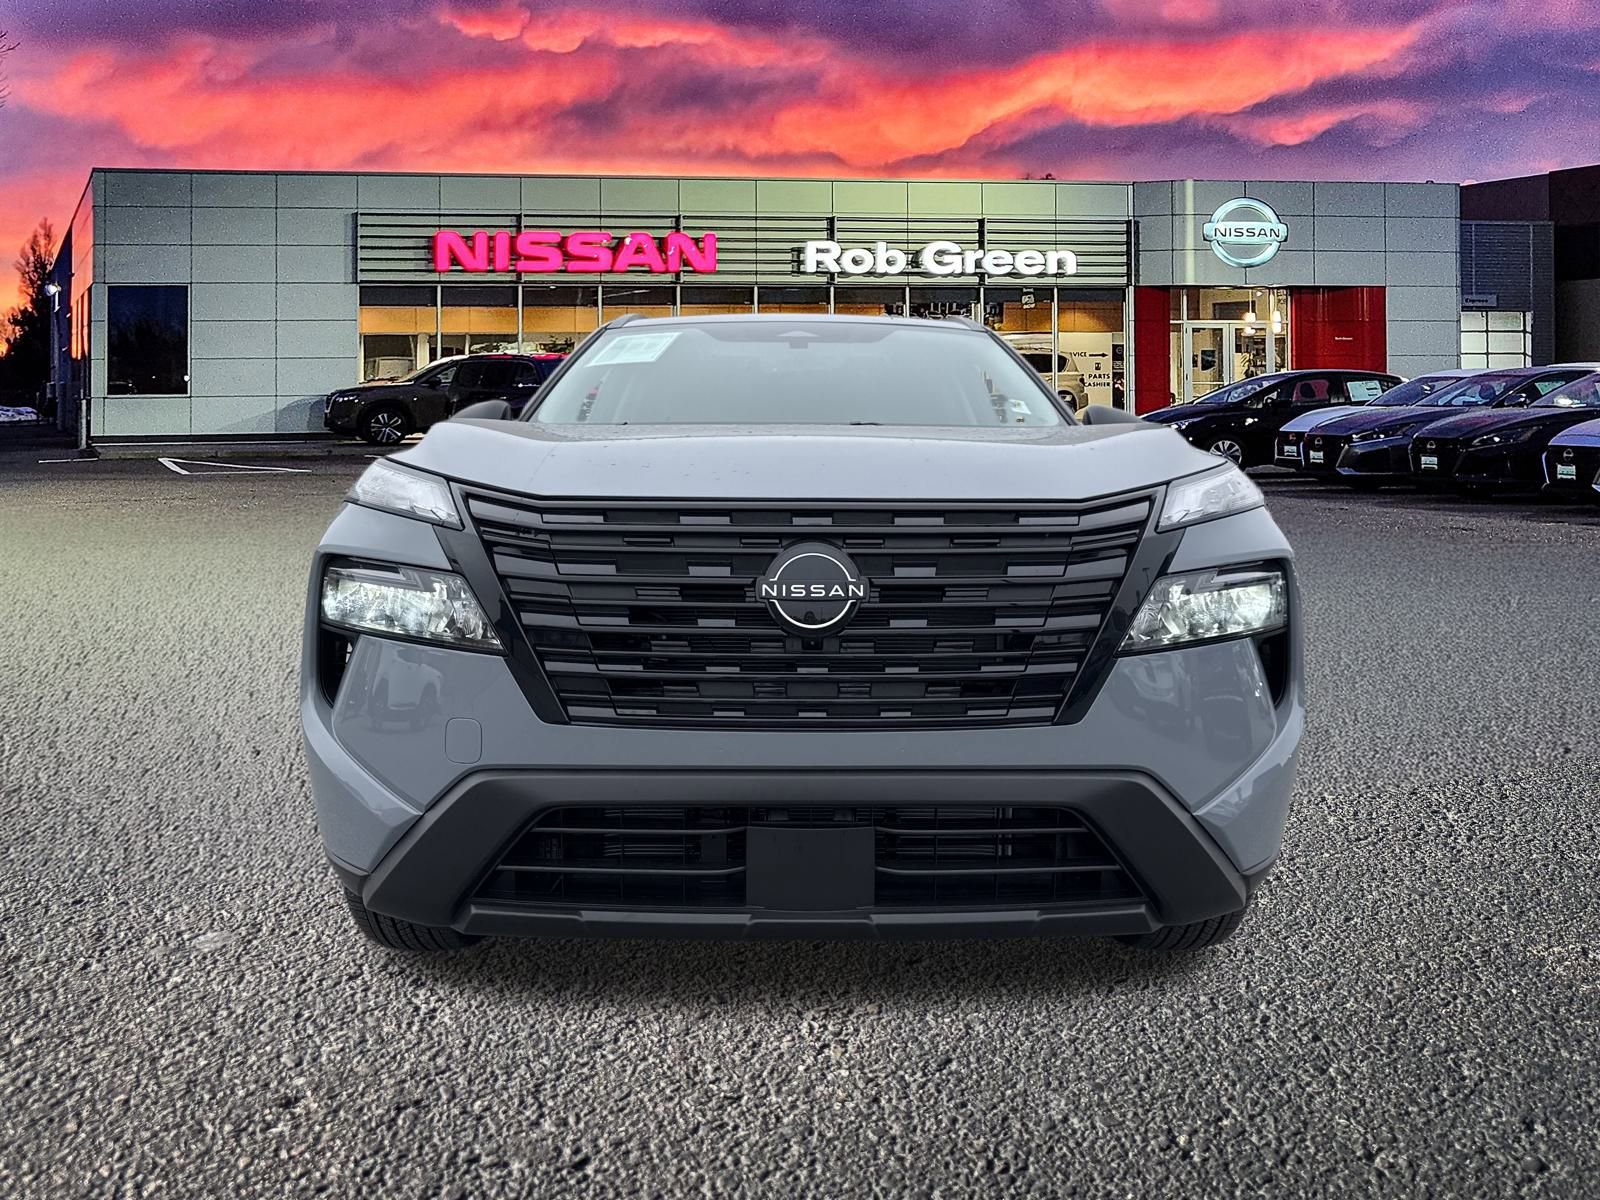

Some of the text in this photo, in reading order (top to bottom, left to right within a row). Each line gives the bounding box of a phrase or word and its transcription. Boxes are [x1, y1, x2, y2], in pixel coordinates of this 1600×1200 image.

[1214, 227, 1280, 238] NISSAN
[432, 230, 718, 273] NISSAN
[804, 240, 1078, 275] Rob Green
[761, 583, 864, 597] NISSAN
